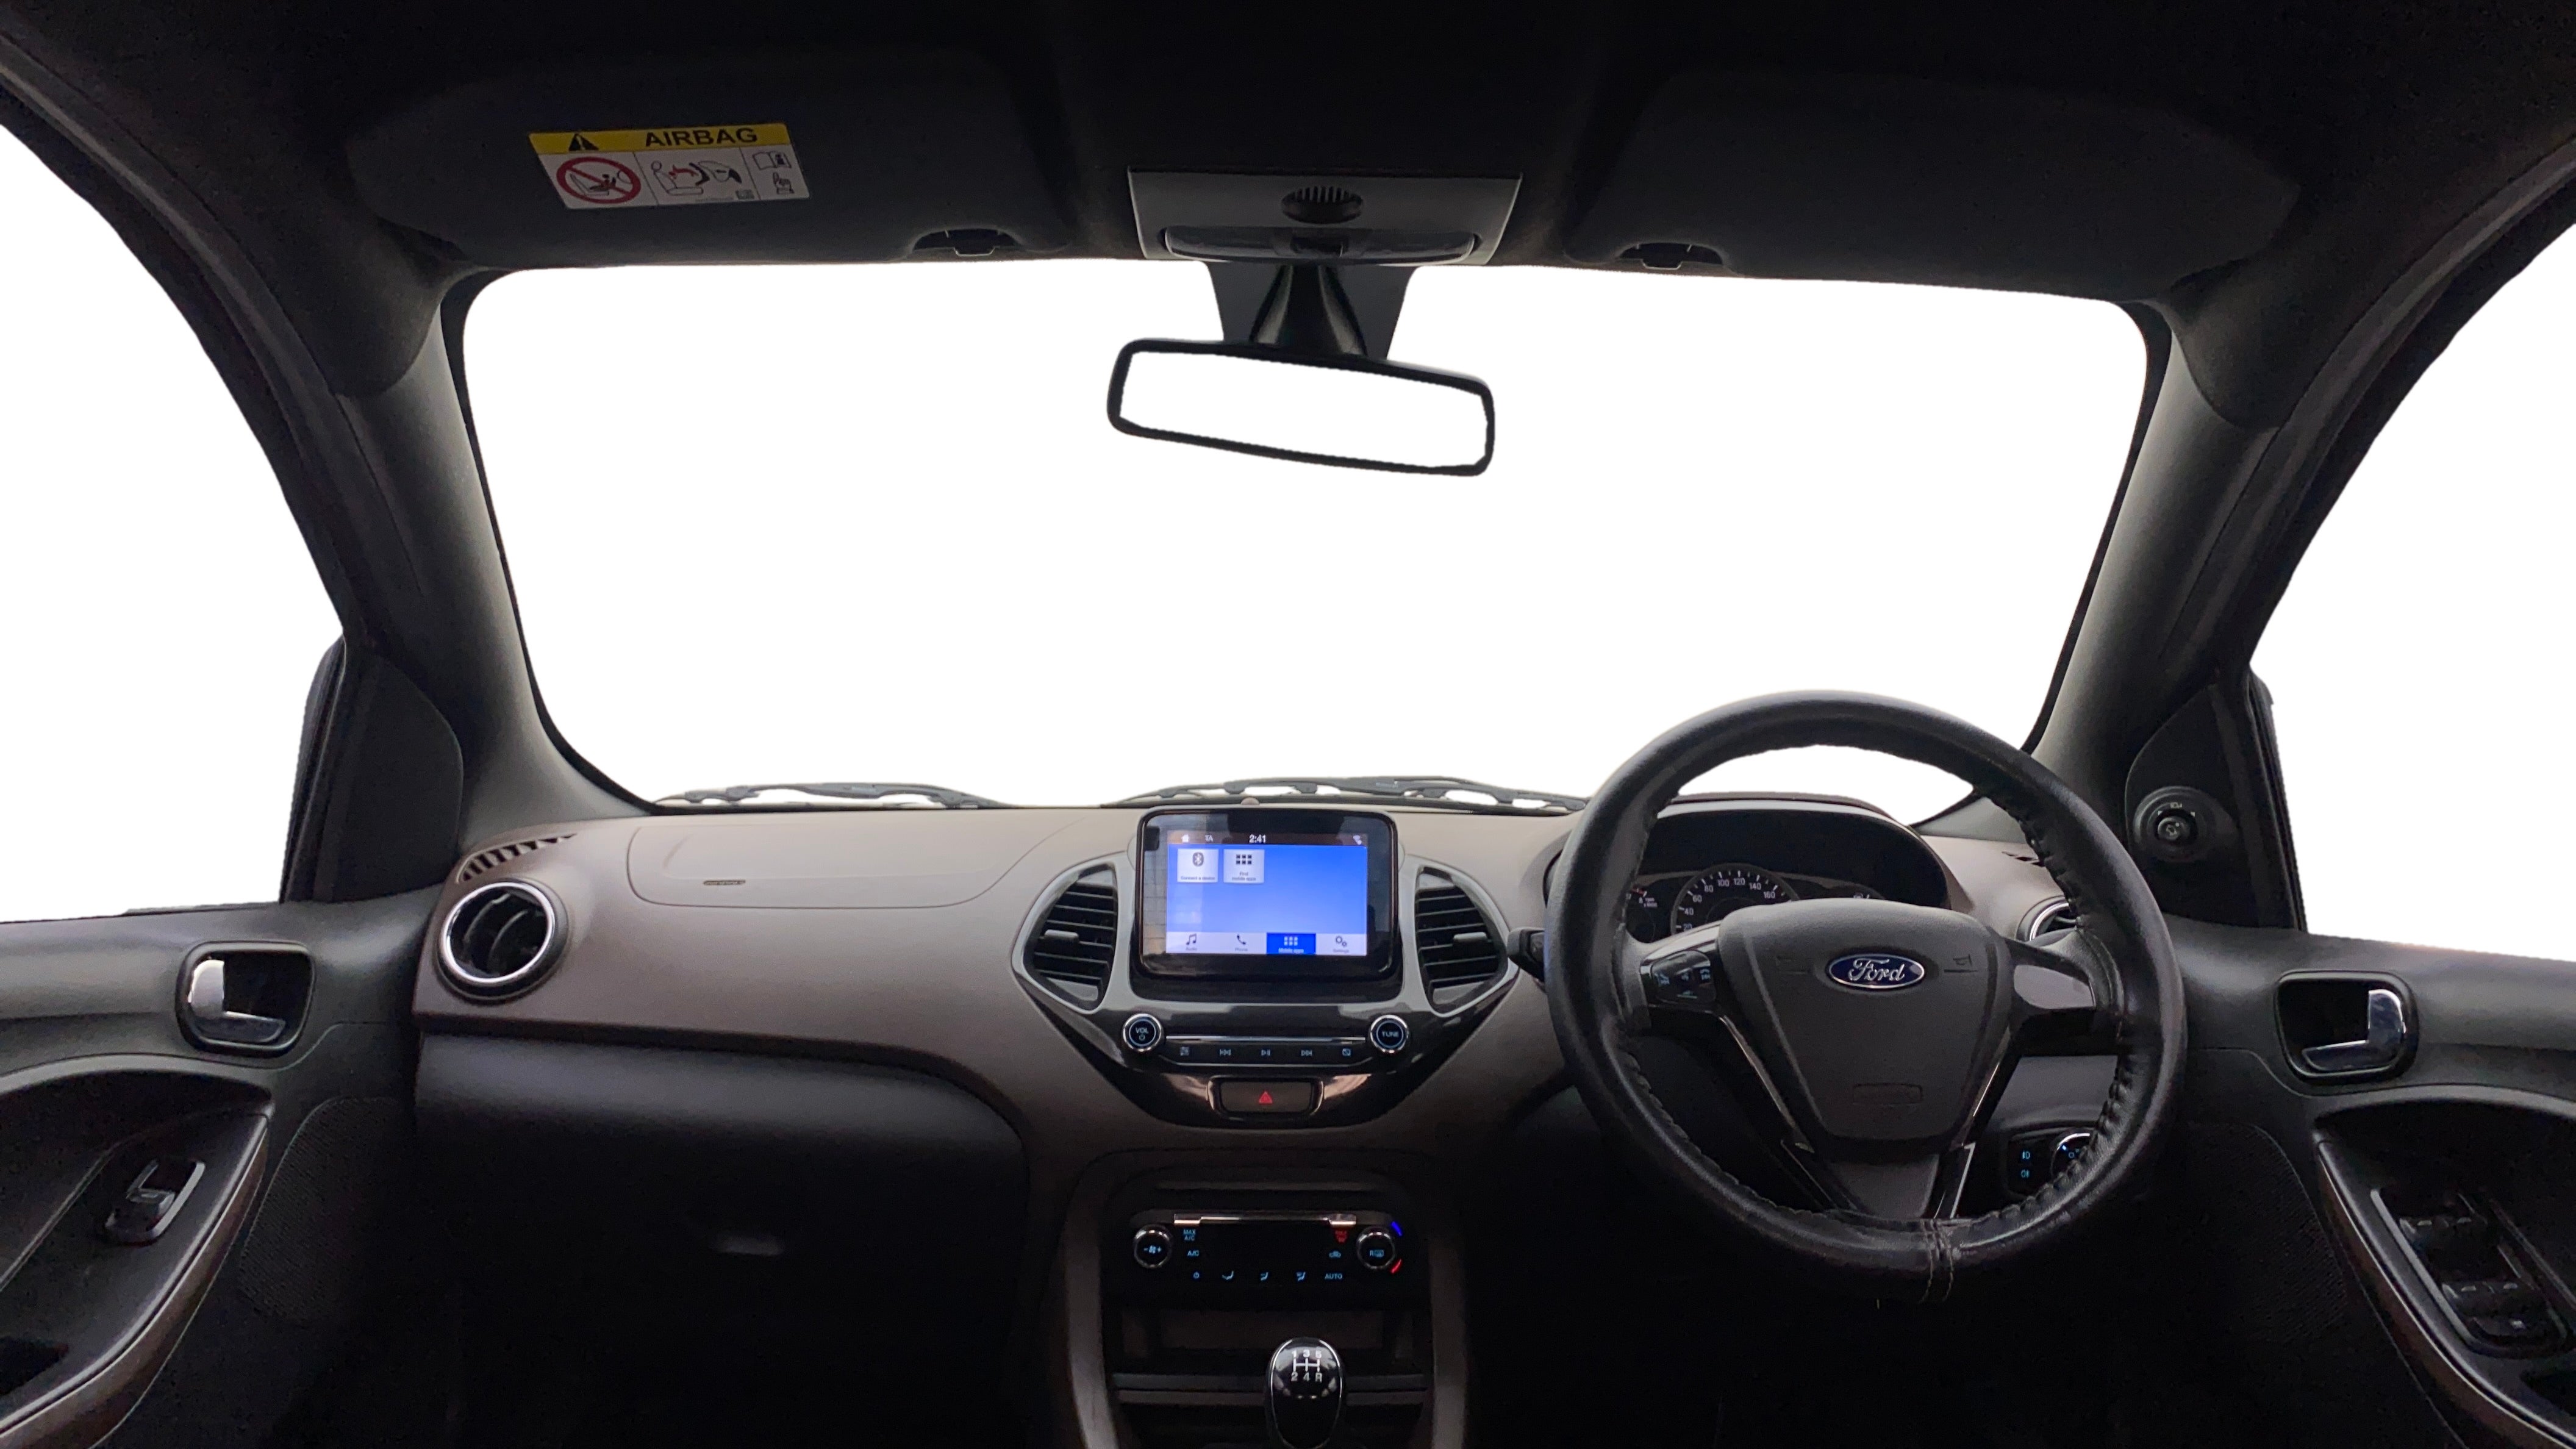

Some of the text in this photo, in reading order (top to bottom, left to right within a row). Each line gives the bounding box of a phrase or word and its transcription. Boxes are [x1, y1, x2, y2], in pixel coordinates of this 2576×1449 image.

[645, 127, 757, 146] AIRBAG
[1249, 834, 1267, 843] 2:41
[1848, 958, 1905, 981] Ford
[1303, 1348, 1311, 1358] 3
[1315, 1349, 1322, 1359] 5
[1290, 1371, 1322, 1383] 2 4 R
